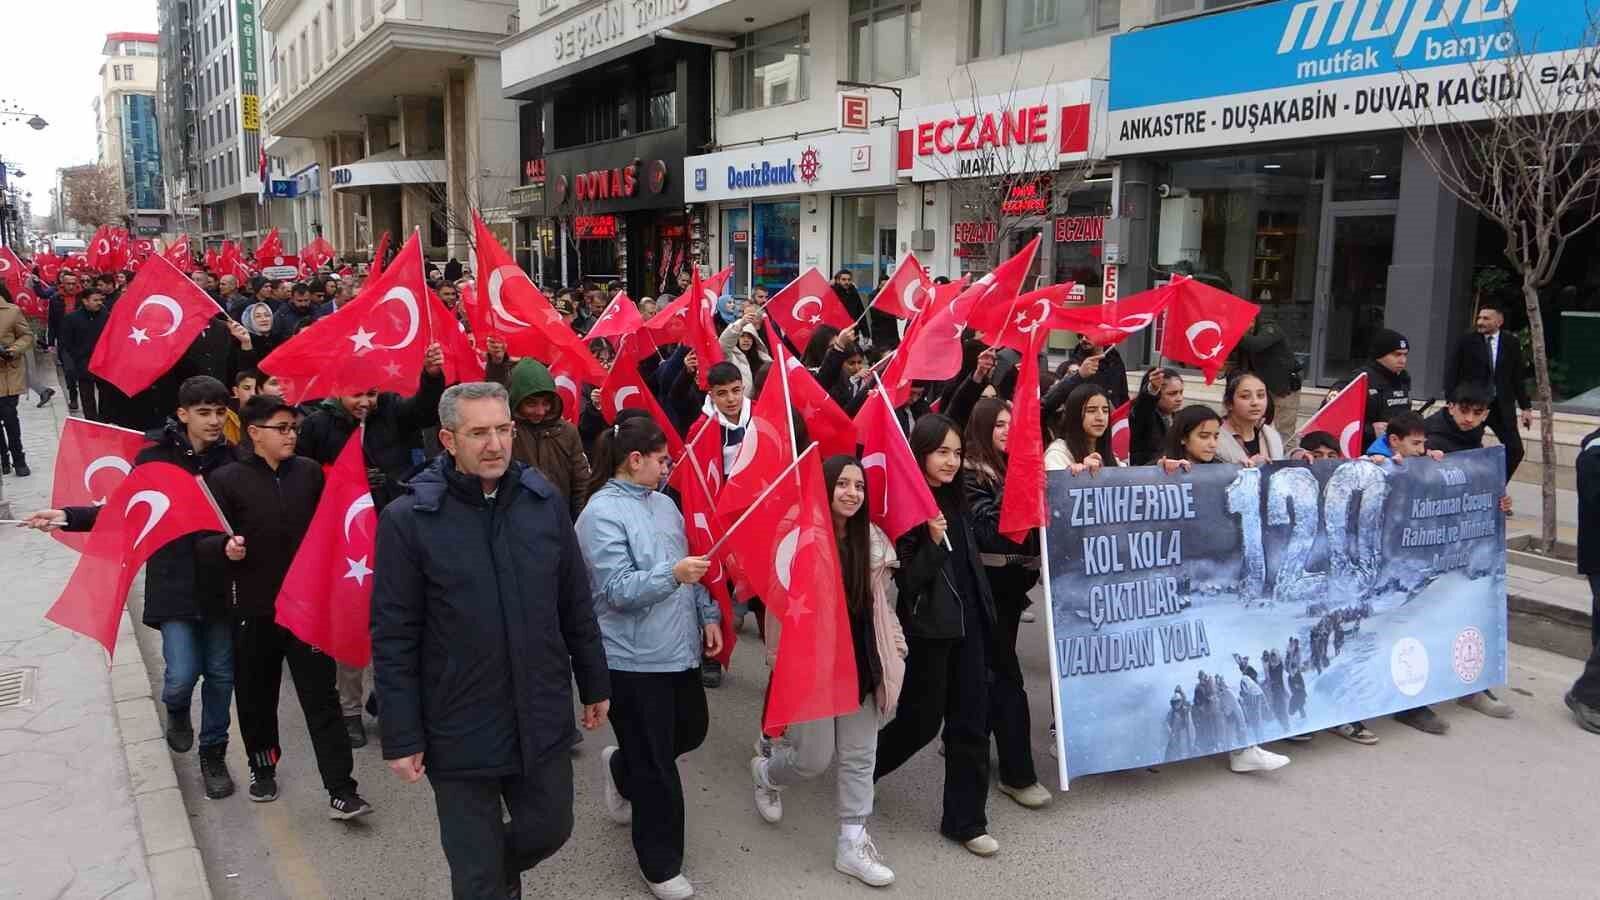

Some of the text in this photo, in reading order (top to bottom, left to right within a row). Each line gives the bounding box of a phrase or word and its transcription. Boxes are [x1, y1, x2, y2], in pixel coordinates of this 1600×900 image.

[1297, 32, 1513, 79] mutfak banyo
[847, 101, 864, 125] E
[1119, 110, 1206, 141] ANKASTRE
[1222, 89, 1337, 133] DUŞAKABİN
[1355, 80, 1429, 114] DUVAR
[1437, 69, 1524, 107] KAĞIDI
[918, 104, 1049, 157] ECZANE
[727, 157, 796, 190] DenizBank
[954, 221, 998, 243] ECZAN
[1055, 216, 1105, 242] ECZAN
[1226, 460, 1388, 600] 120
[1411, 497, 1461, 519] Kahraman
[1082, 529, 1182, 576] KOL KOLA
[1401, 525, 1446, 547] Rahmet
[1447, 526, 1459, 542] ve
[1088, 576, 1181, 630] ÇIKTILAR
[1057, 618, 1211, 678] VANDAN YOLA
